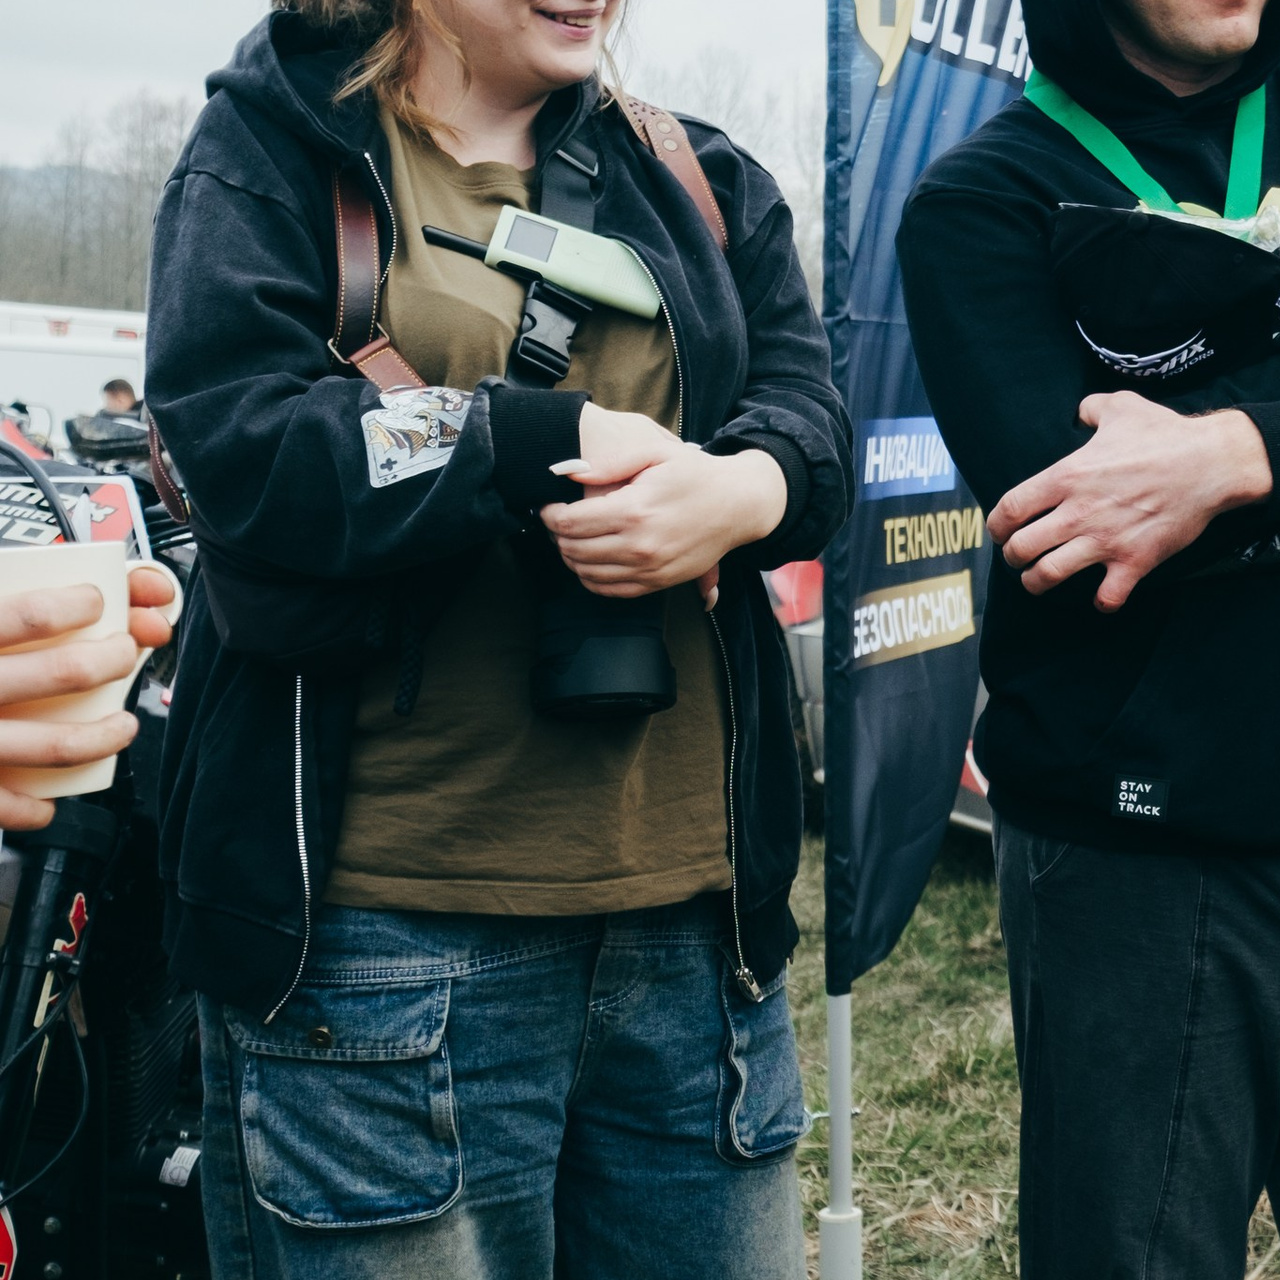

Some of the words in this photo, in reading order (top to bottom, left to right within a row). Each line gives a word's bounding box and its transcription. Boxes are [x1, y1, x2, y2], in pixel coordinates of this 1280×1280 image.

[1120, 780, 1152, 793] STAY
[1119, 791, 1138, 802] ON
[1118, 801, 1161, 816] TRACK
